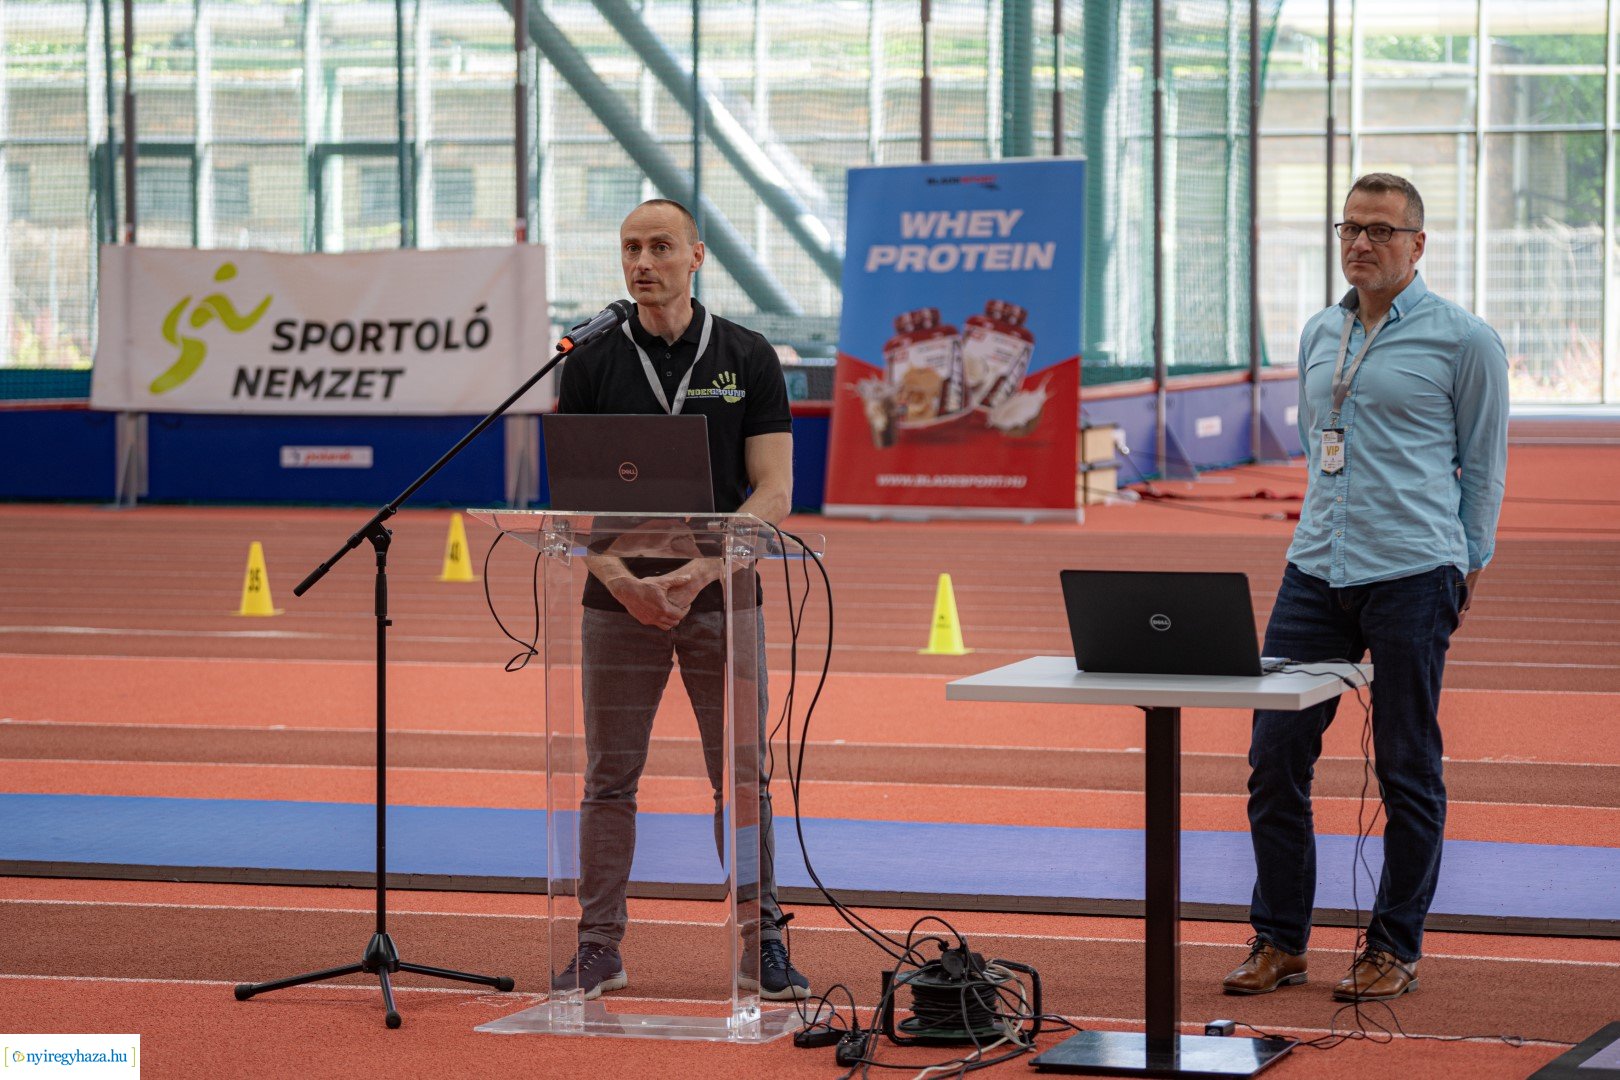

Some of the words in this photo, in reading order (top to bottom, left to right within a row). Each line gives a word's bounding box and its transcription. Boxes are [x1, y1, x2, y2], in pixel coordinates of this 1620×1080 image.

[900, 209, 1024, 239] WHEY
[865, 242, 1056, 273] PROTEIN
[270, 304, 492, 353] SPORTOLÓ
[231, 366, 404, 401] NEMZET
[687, 388, 746, 398] NDERGROUND
[1326, 445, 1340, 456] VIP
